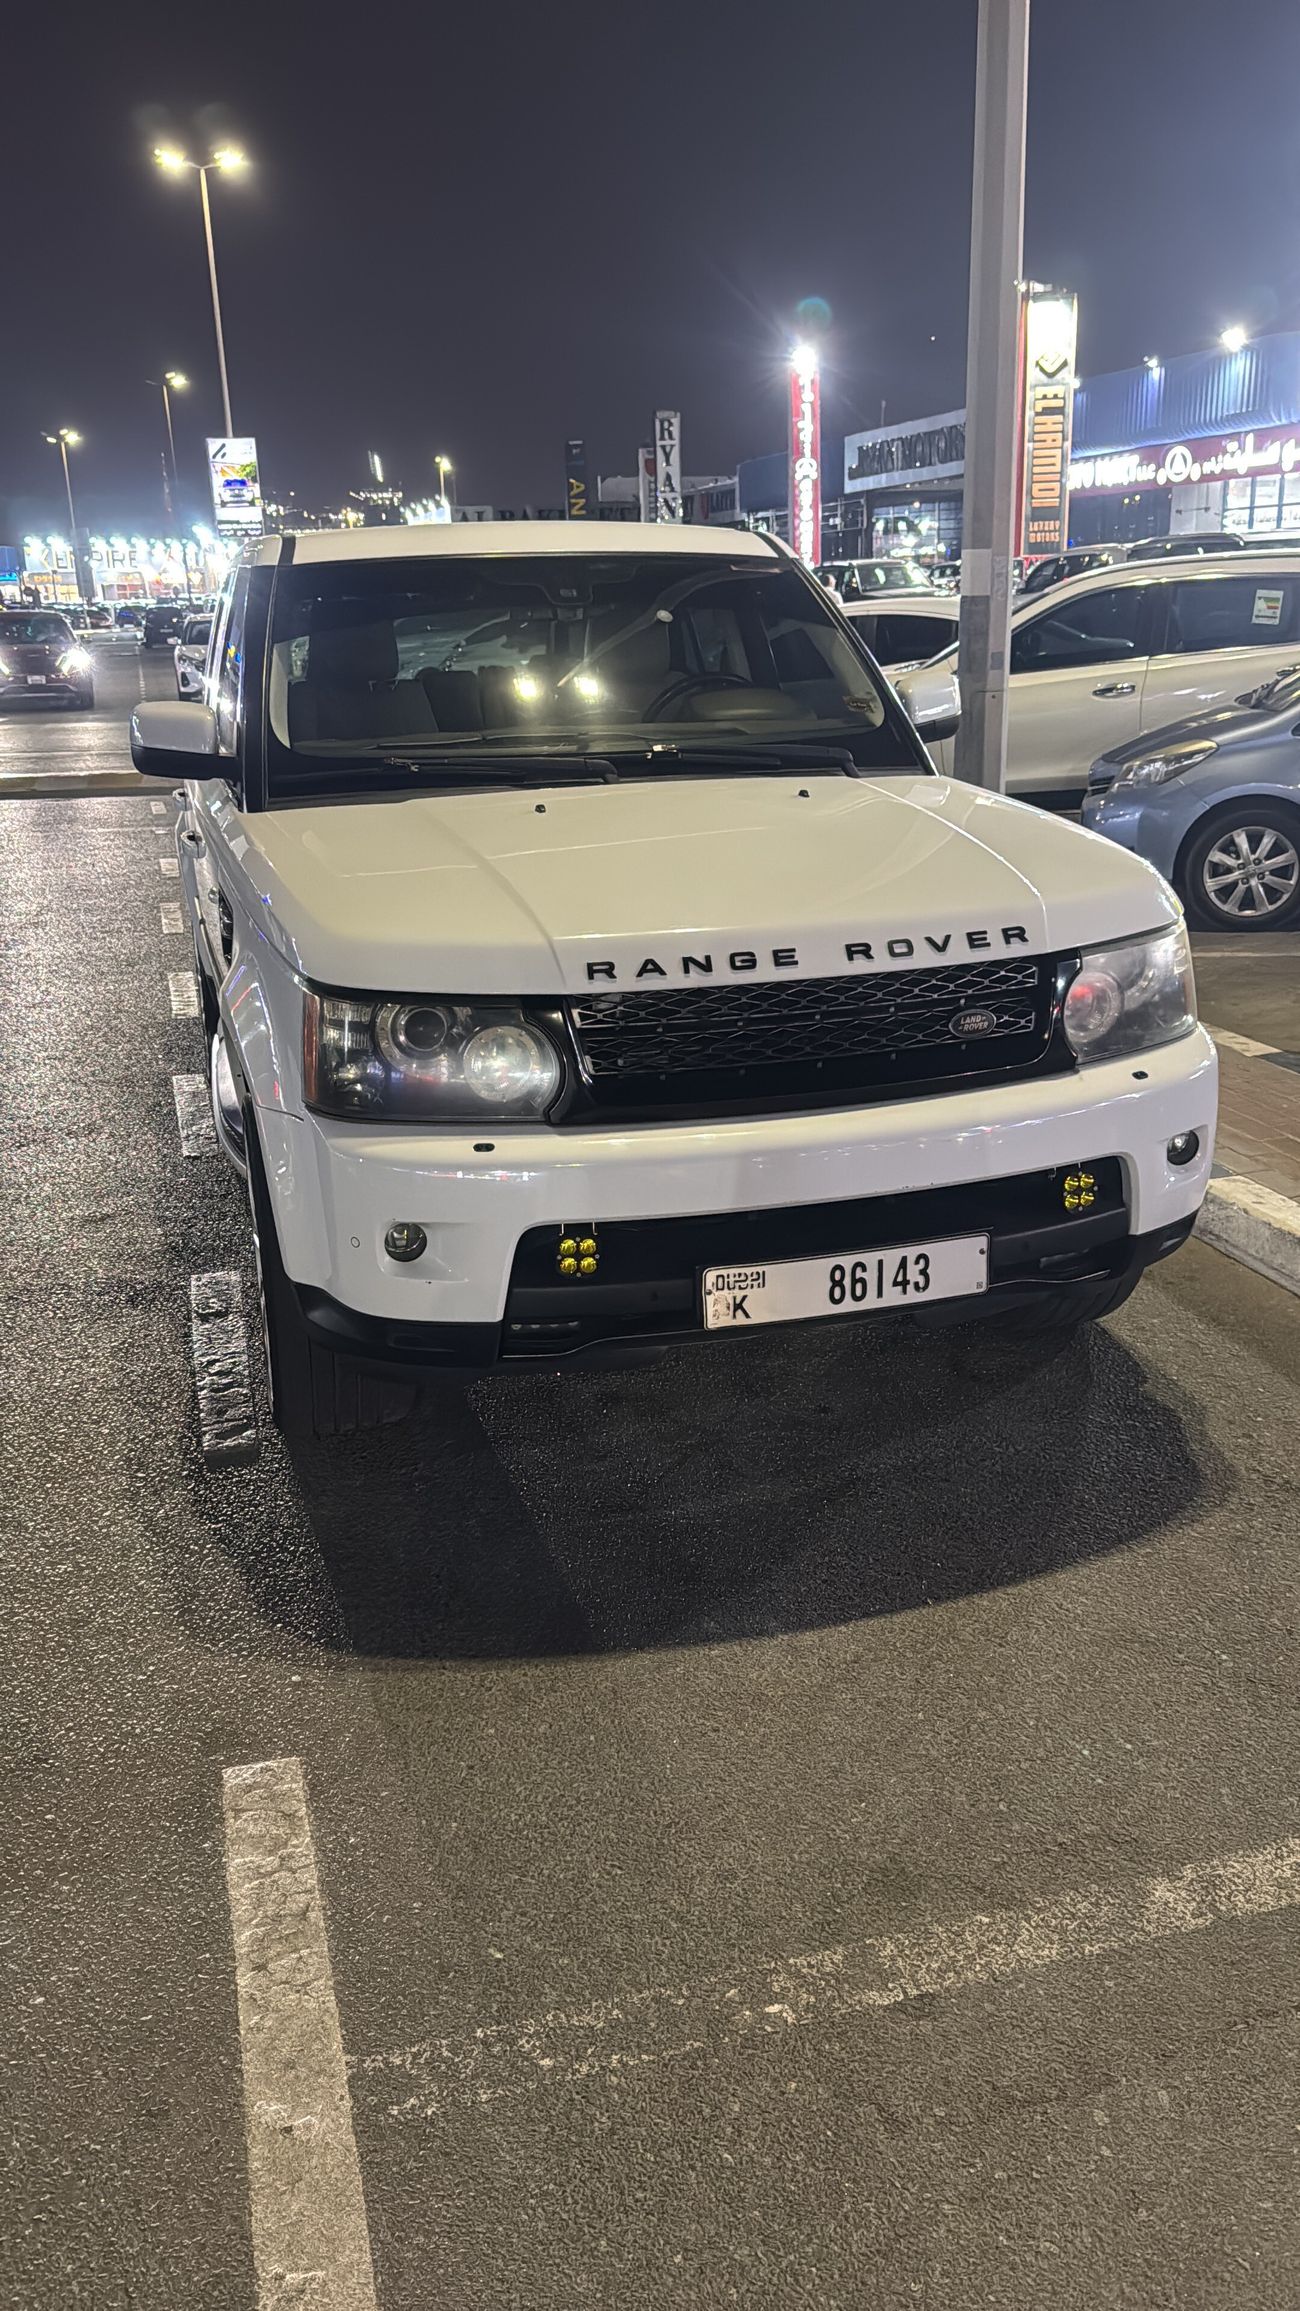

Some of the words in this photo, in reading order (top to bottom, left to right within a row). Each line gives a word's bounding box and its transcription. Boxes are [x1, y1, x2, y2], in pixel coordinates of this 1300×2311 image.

[1034, 385, 1065, 412] EL
[658, 418, 681, 520] RYAN
[1032, 415, 1064, 507] HAMIDI
[1029, 532, 1060, 544] MOTORS
[586, 947, 799, 981] RANGE
[845, 925, 1029, 961] ROVER
[960, 1014, 982, 1025] LAND
[963, 1021, 989, 1031] ROVER
[828, 1253, 931, 1306] 86143
[732, 1294, 752, 1320] K
